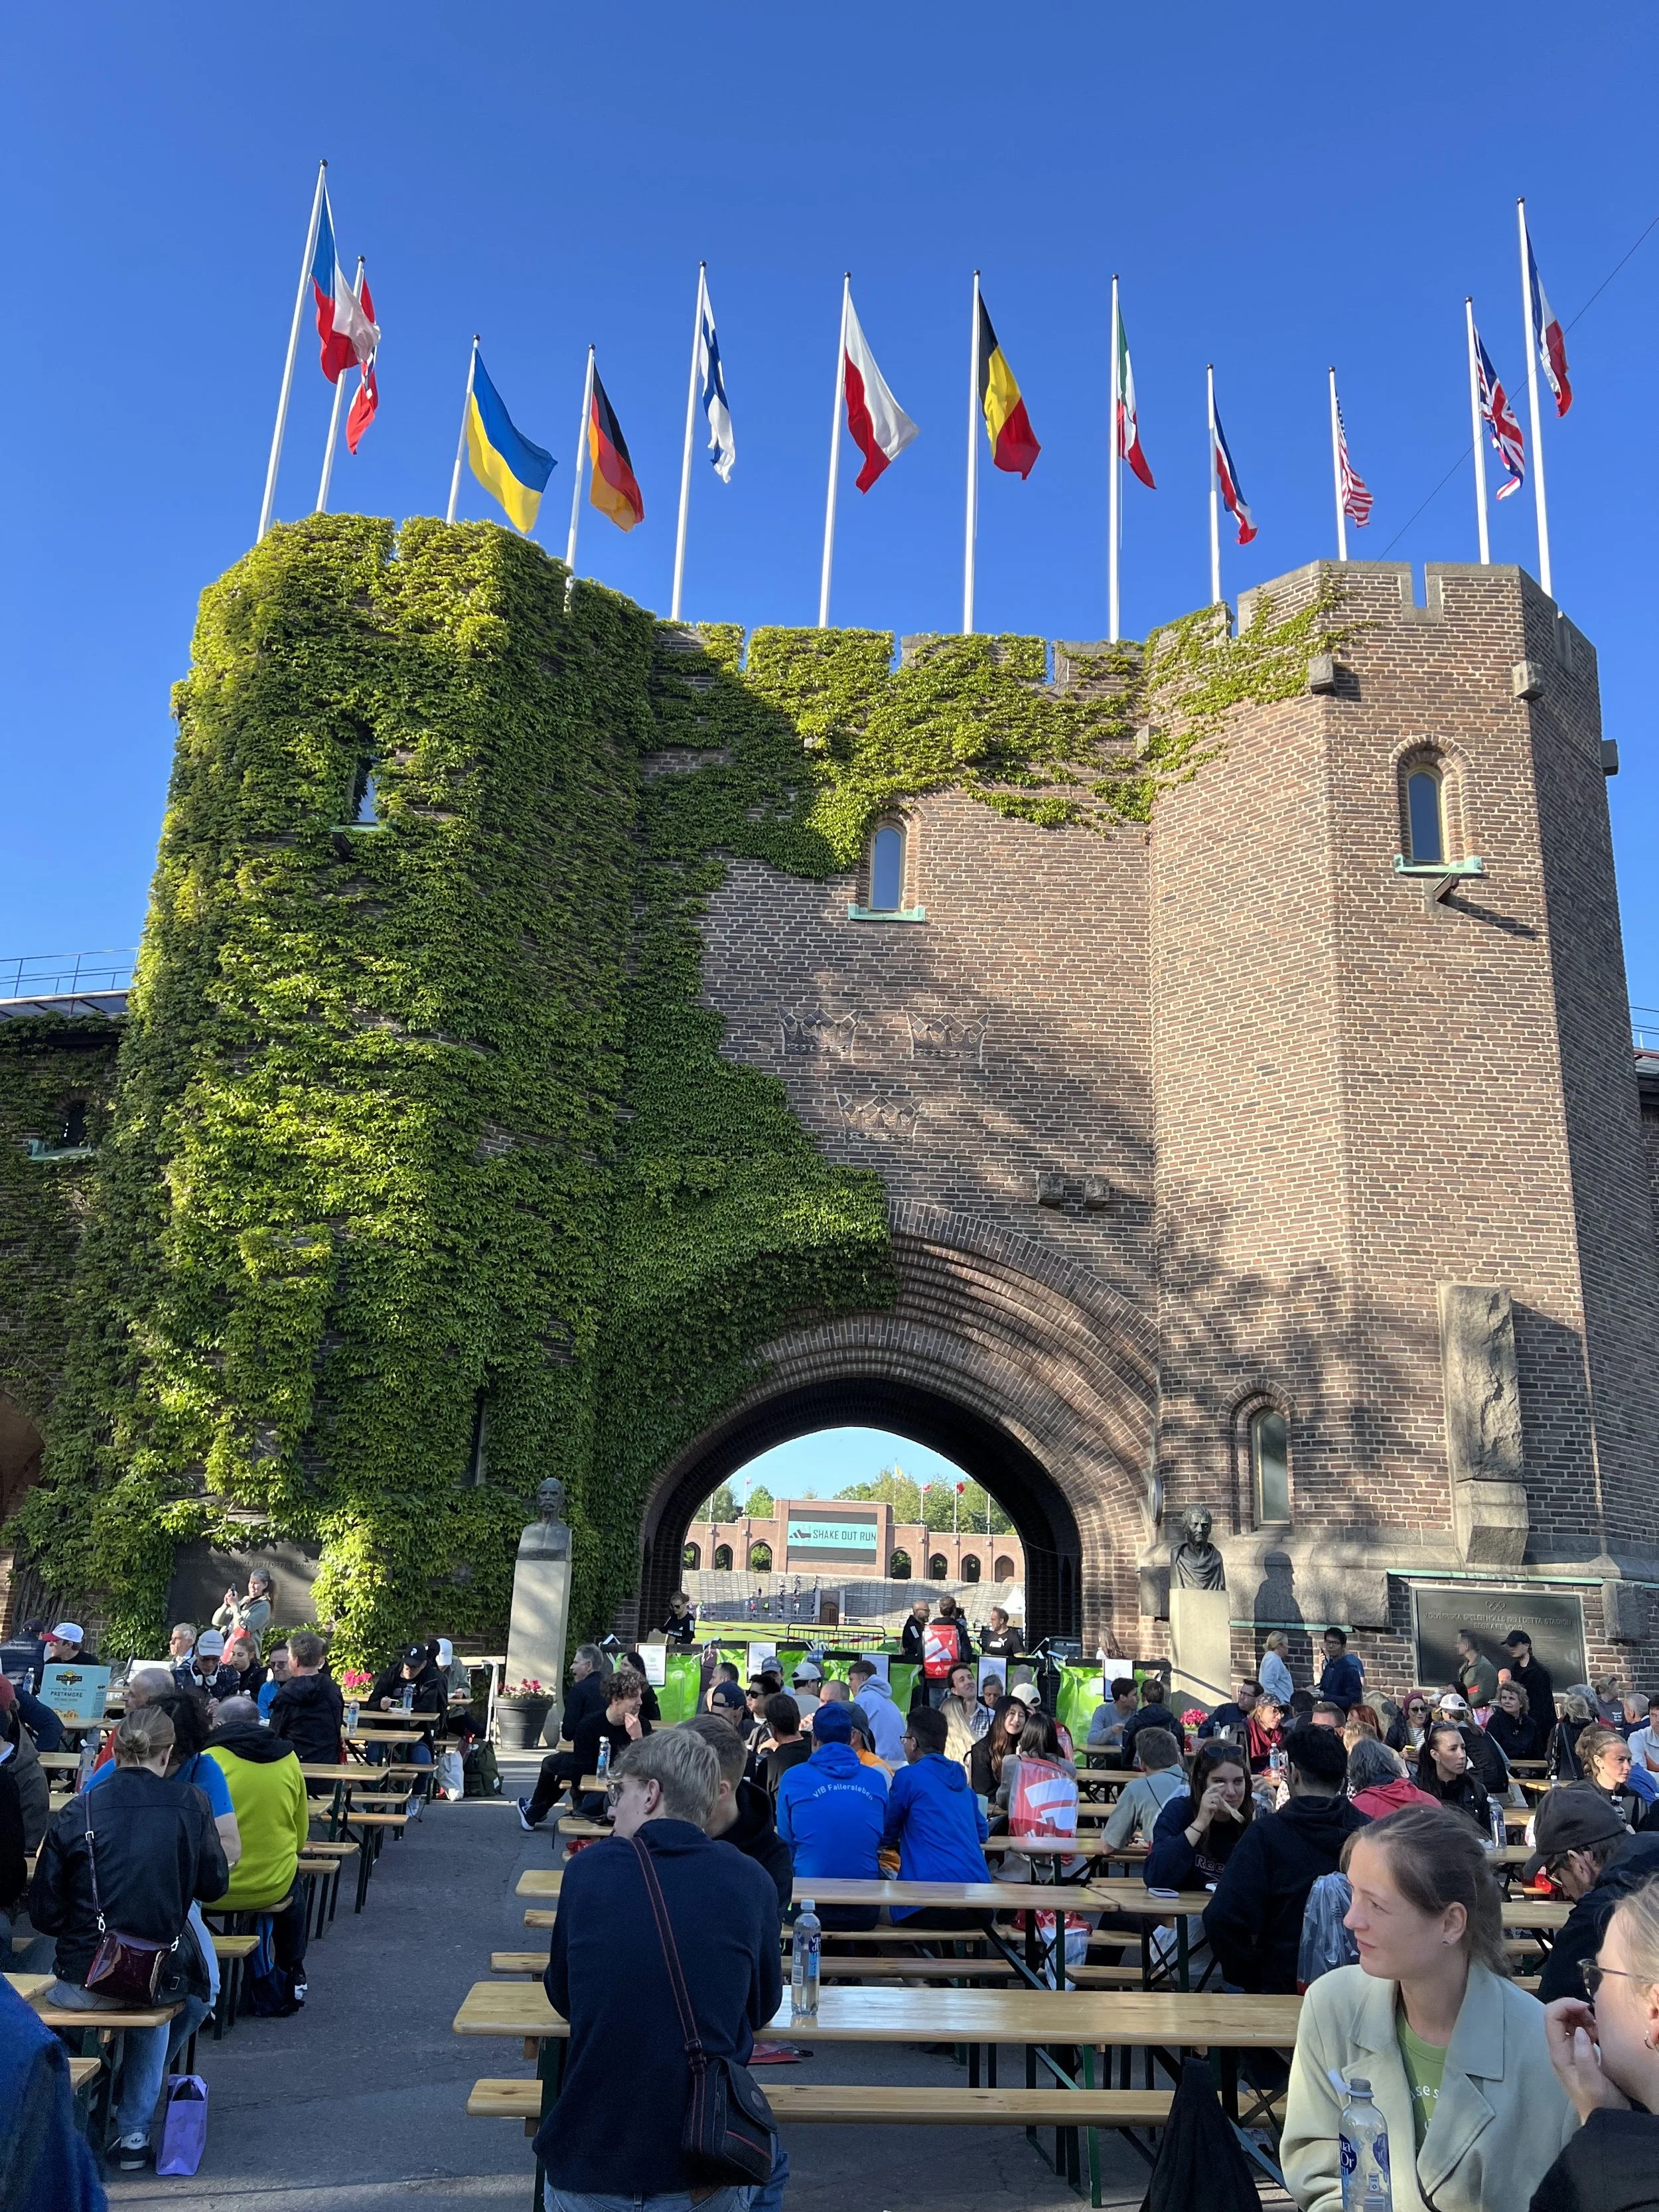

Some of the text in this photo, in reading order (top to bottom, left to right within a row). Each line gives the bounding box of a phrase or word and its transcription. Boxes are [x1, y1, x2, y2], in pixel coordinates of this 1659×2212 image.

[813, 1529, 876, 1541] SHAKE OUT RUN
[1544, 1617, 1573, 1626] STADION
[812, 1783, 873, 1801] VfB Fallersleben
[1195, 1854, 1225, 1874] Ree
